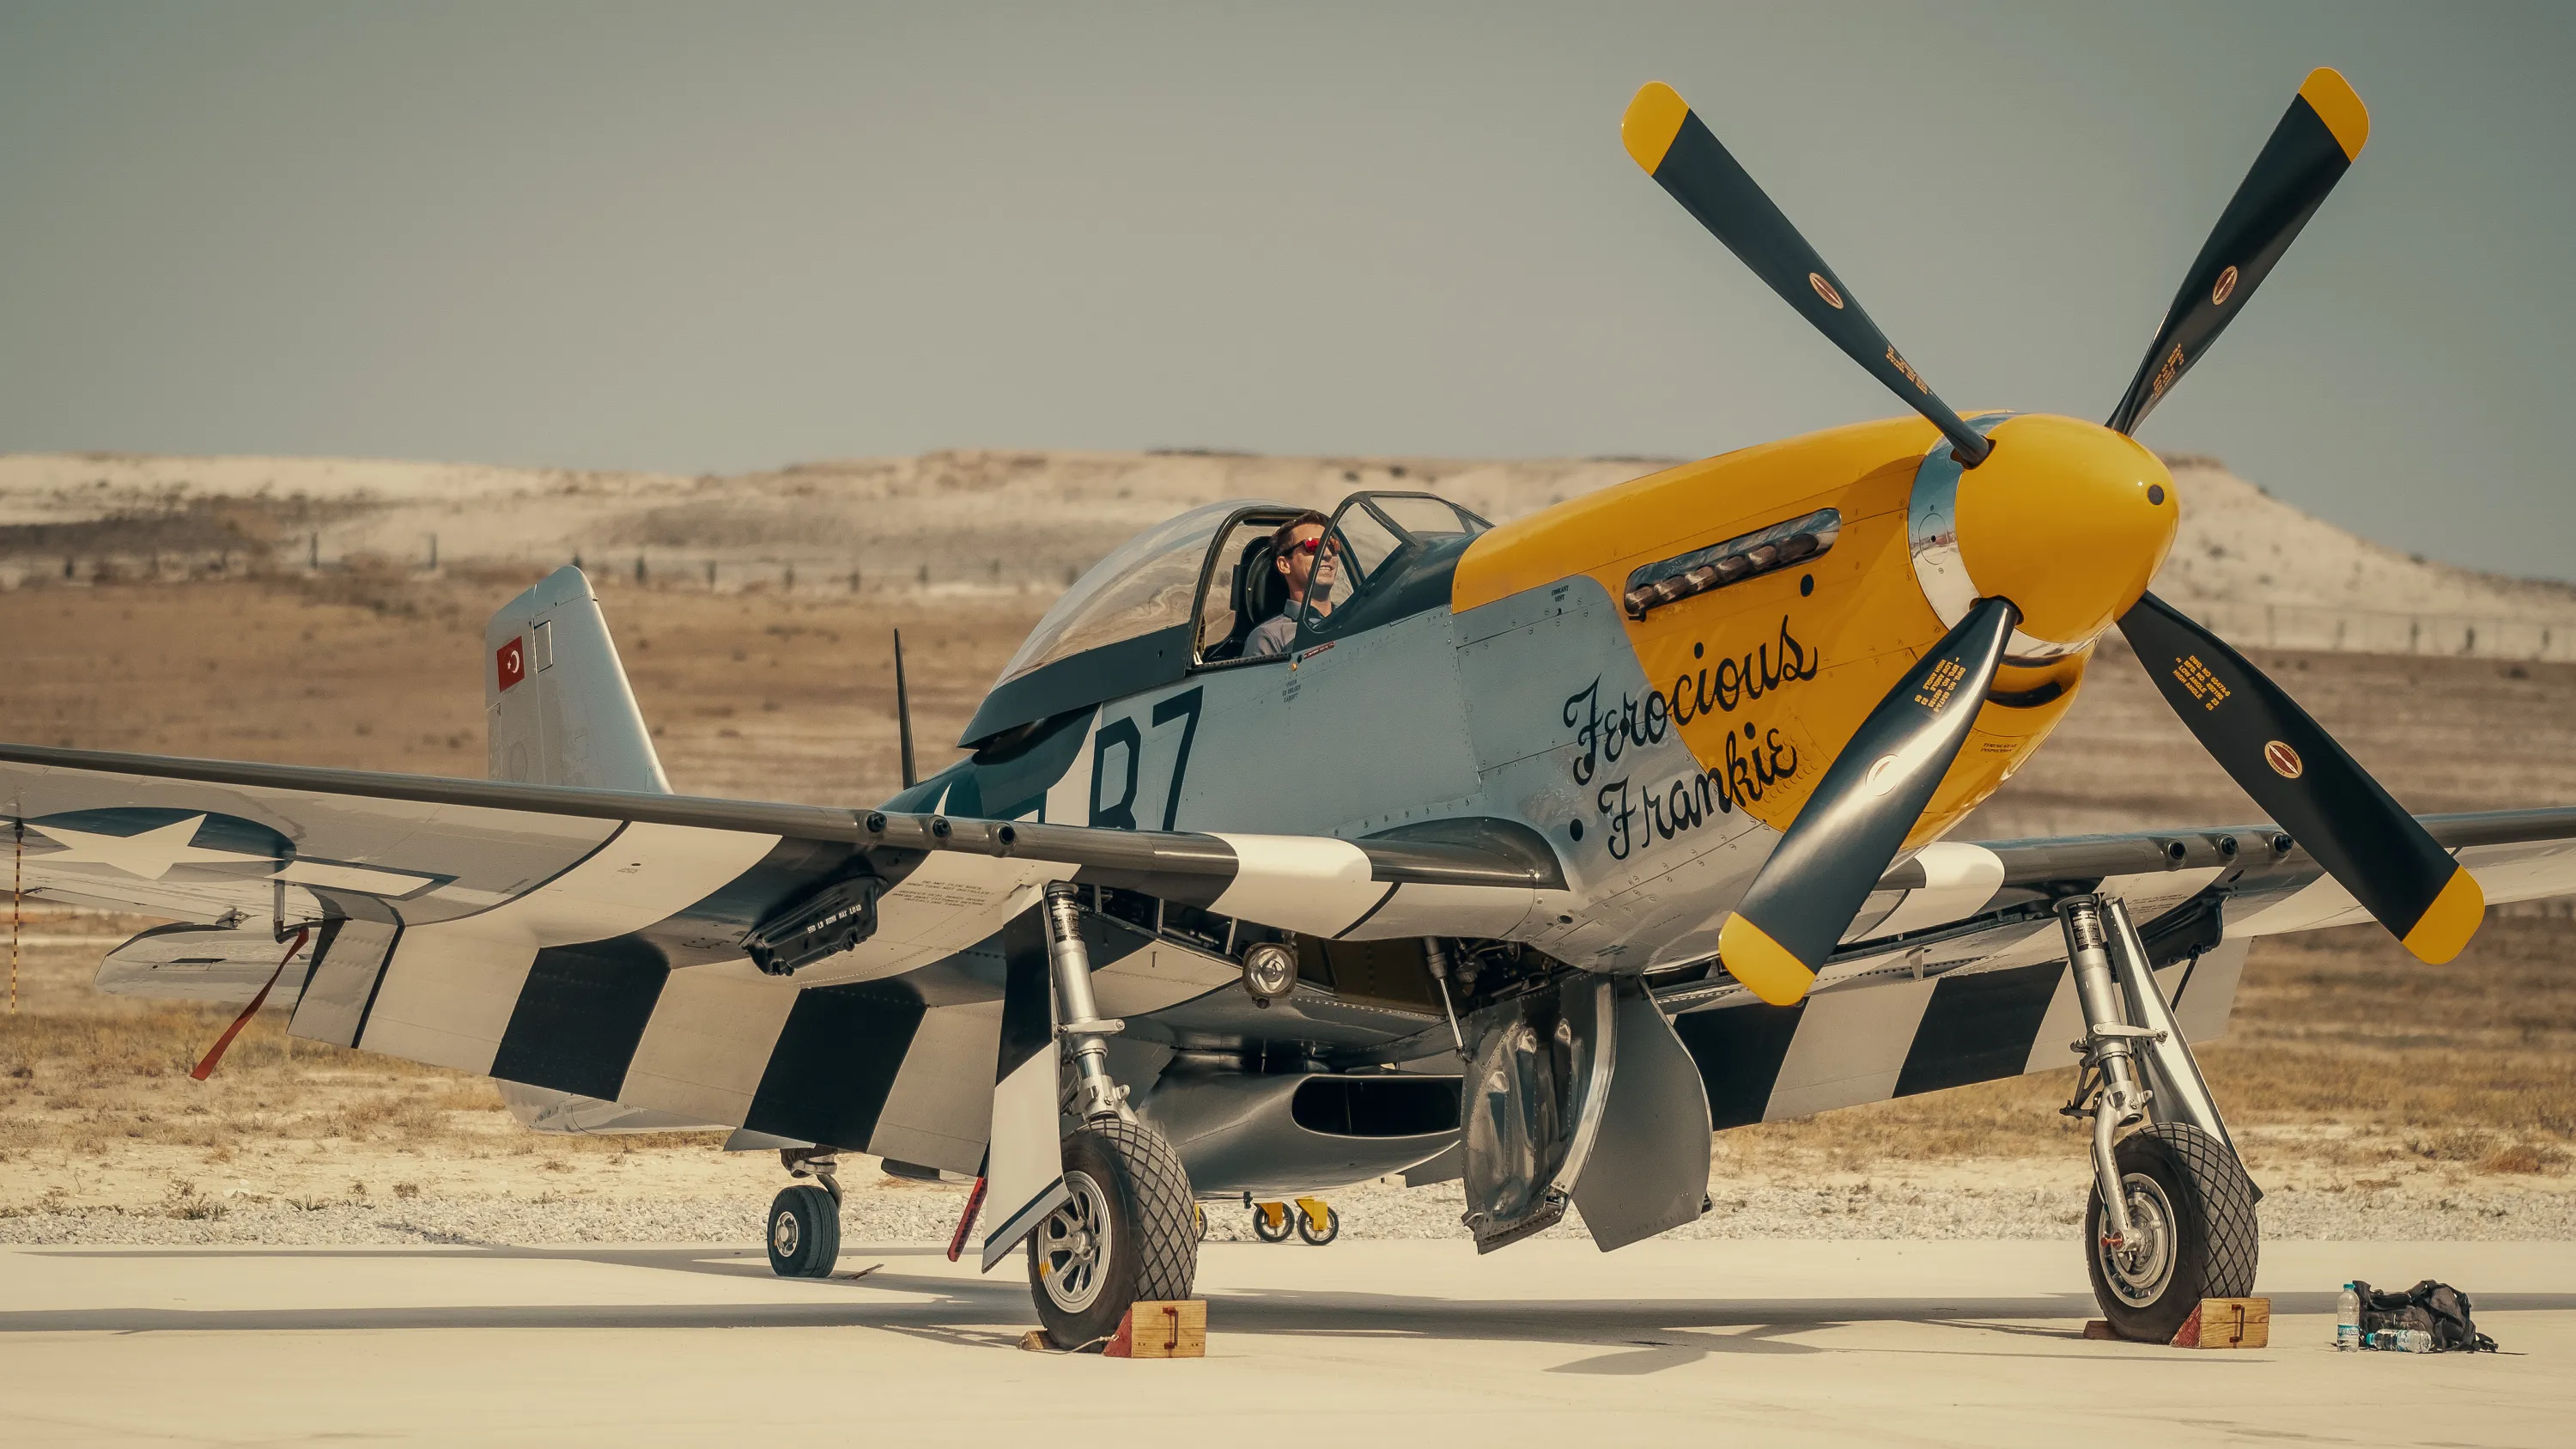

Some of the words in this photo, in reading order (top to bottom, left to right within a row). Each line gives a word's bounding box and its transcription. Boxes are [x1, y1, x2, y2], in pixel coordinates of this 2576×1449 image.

[1941, 661, 1953, 675] LOW
[2178, 665, 2191, 678] LOW
[2189, 676, 2207, 693] ANGLE
[1923, 672, 1937, 690] ANGLE
[1929, 673, 1945, 692] ANGLE
[2173, 670, 2187, 684] HIGH
[2185, 682, 2202, 699] ANGLE
[1563, 614, 1818, 785] Ferocious
[1598, 721, 1797, 860] Frankie
[849, 904, 862, 915] LOAD
